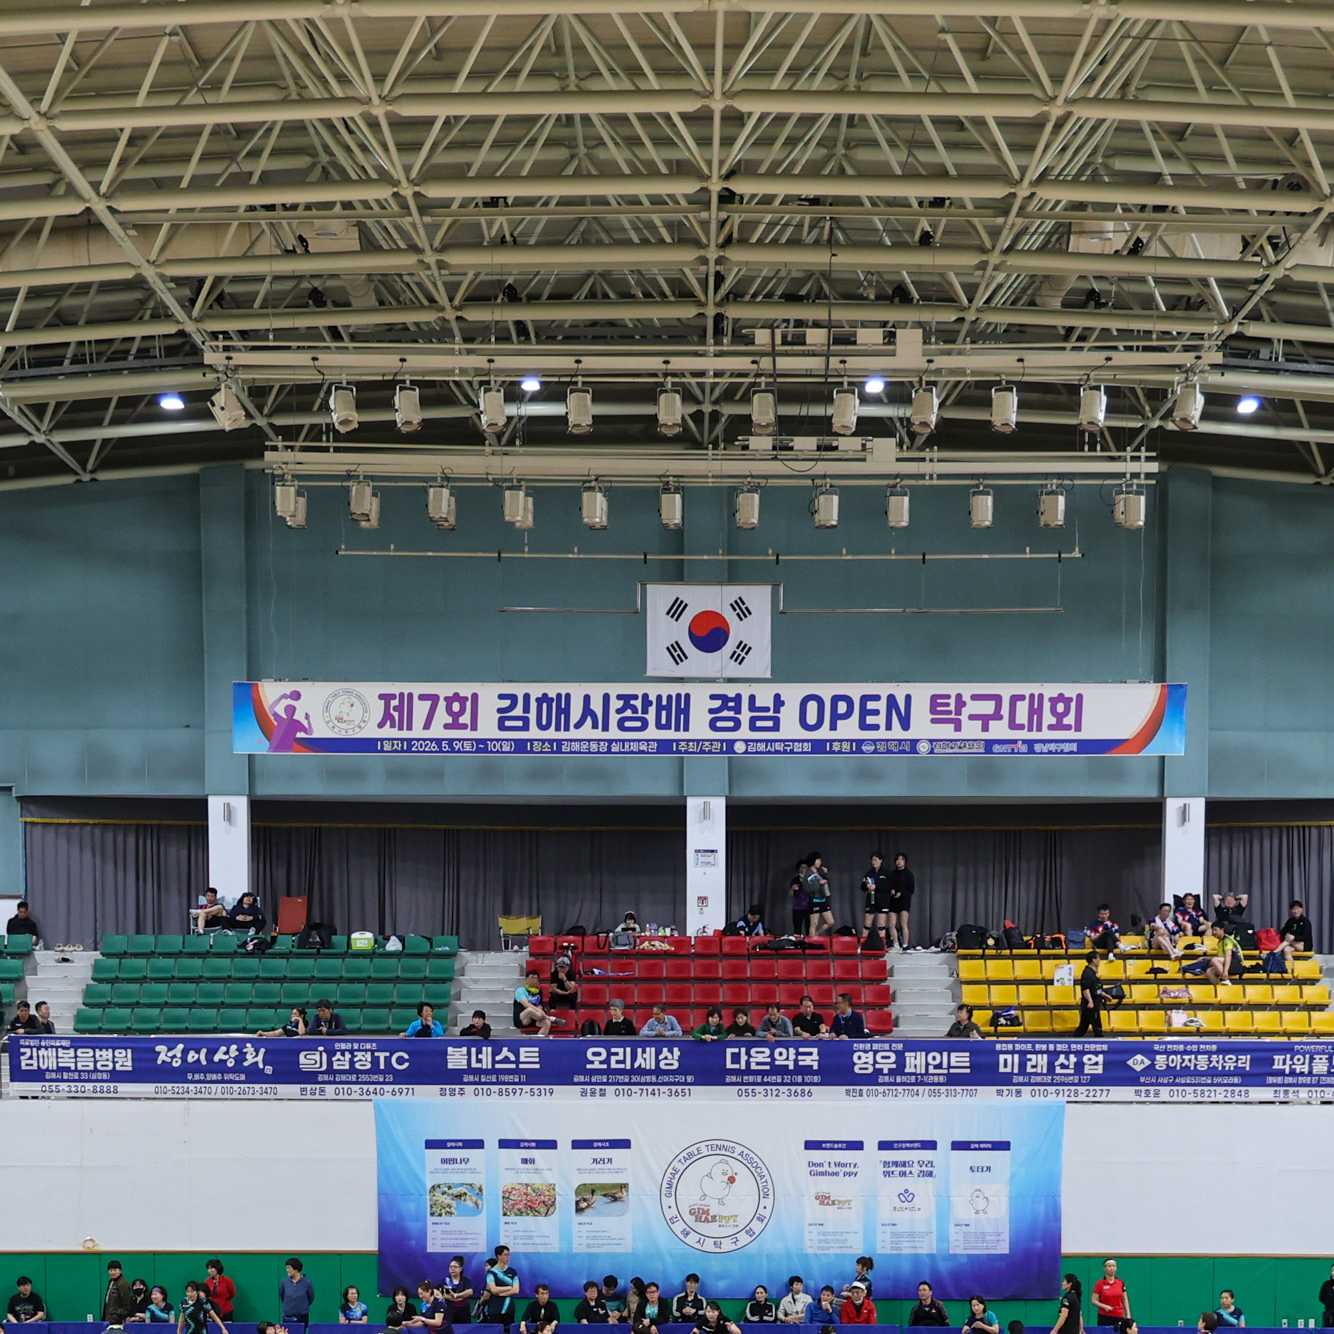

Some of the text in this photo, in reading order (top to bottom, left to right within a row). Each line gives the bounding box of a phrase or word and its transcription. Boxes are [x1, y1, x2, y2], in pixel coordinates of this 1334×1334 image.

[377, 692, 1083, 732] 제7회 김해시장배 경남 OPEN 탁구대회
[487, 740, 515, 753] 10(일)
[562, 741, 608, 753] 김해운동장
[610, 741, 658, 753] 실내체육관
[747, 741, 811, 753] 김해시탁구협회
[20, 1048, 132, 1071] 김해복음병원
[331, 1051, 410, 1070] 삼정TC
[447, 1046, 540, 1070] 볼네스트
[586, 1046, 681, 1070] 오리세상
[726, 1047, 819, 1071] 다온약국
[853, 1051, 971, 1074] 영우 페인트
[998, 1053, 1104, 1074] 미래산업
[1154, 1054, 1250, 1071] 동아자동차유리
[41, 1085, 119, 1094] 055-330-8888
[154, 1086, 278, 1095] 010-5234-3470 010-2673-3470
[334, 1087, 415, 1096] 010-3640-6971
[473, 1088, 555, 1097] 010-8597-5319
[614, 1088, 692, 1097] 010-7141-3651
[737, 1088, 813, 1097] 055-312-3686
[866, 1088, 919, 1097] 010-6712-7704
[927, 1088, 978, 1097] 055-313-7707
[996, 1088, 1110, 1098] 박기동 010-9128-2277
[1169, 1089, 1249, 1098] 010-5821-2848
[665, 1144, 770, 1199] GIMHAE TABLE TENNIS ASSOCIATION
